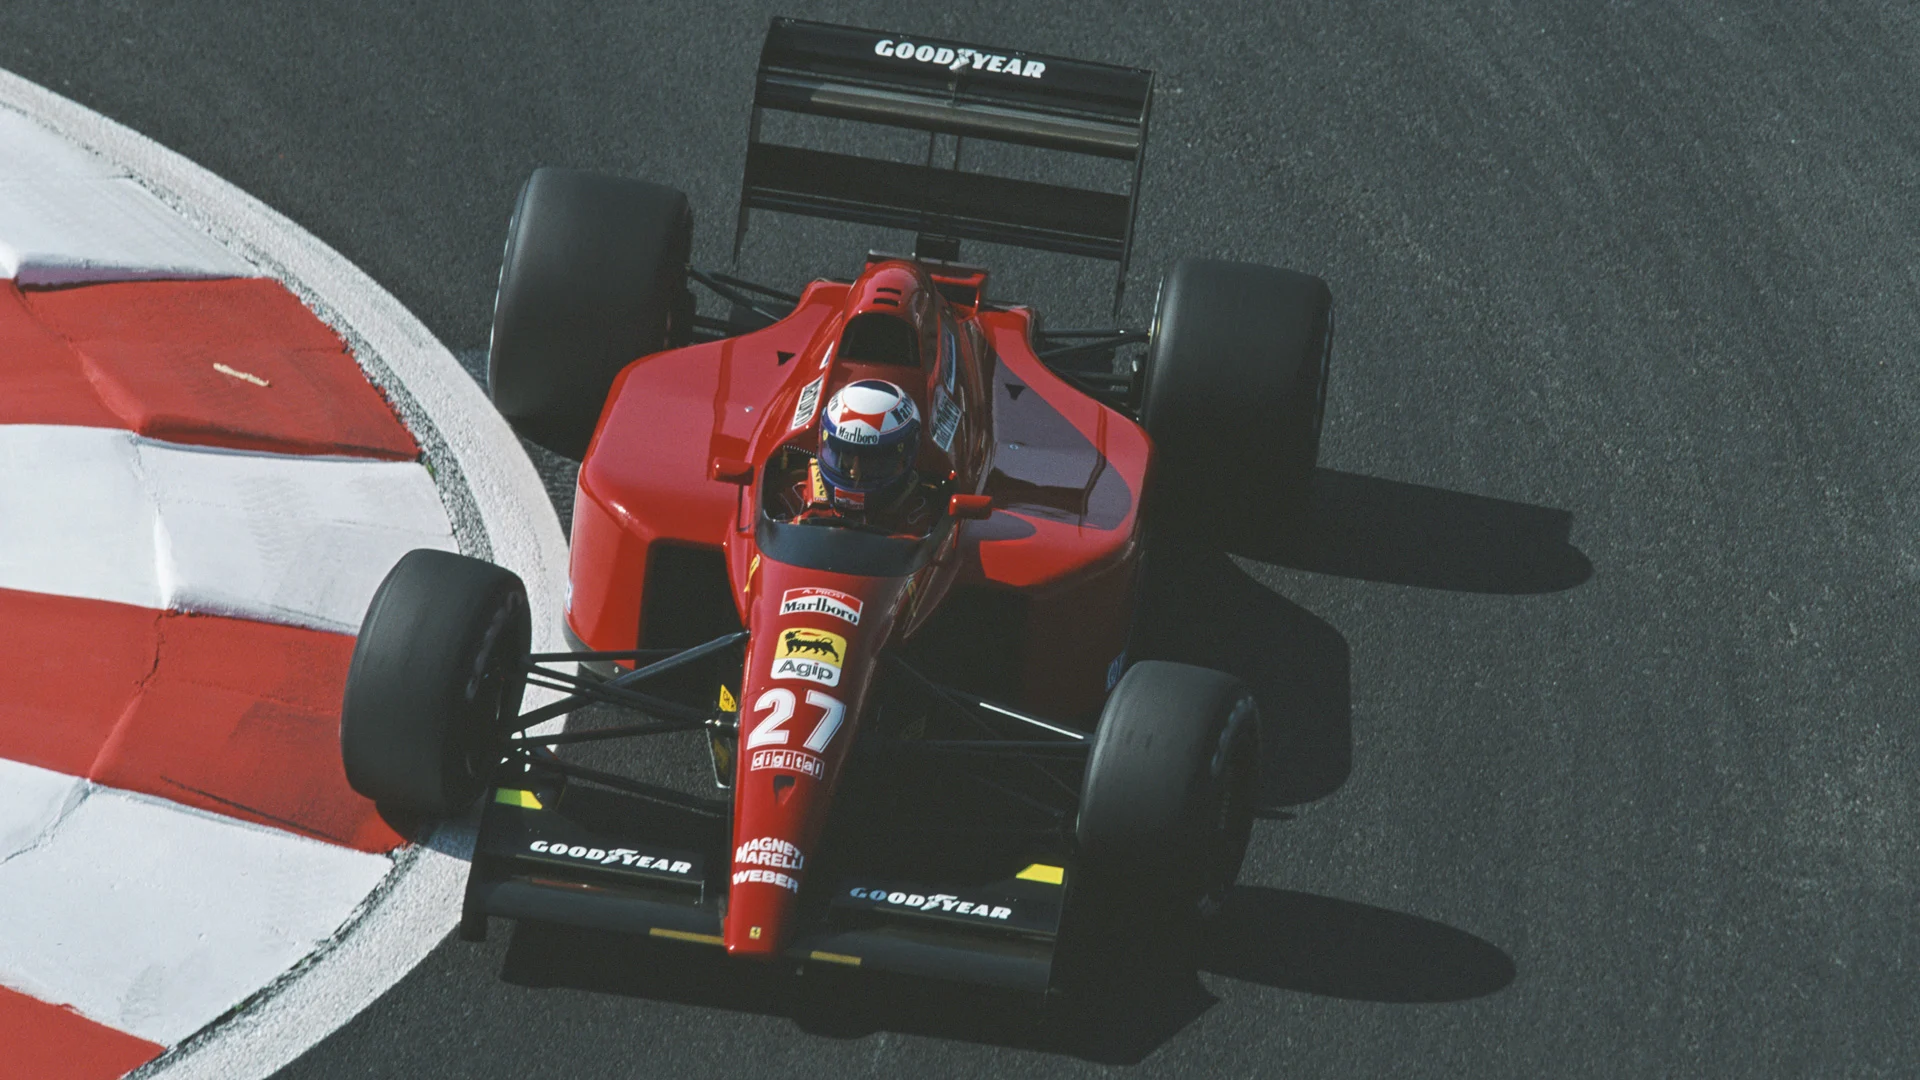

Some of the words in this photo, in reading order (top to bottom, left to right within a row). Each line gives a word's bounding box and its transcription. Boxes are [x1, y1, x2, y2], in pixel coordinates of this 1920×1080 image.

[874, 40, 1046, 78] GOODYEAR
[838, 426, 878, 444] Marlboro
[783, 598, 858, 623] Marlboro
[778, 660, 833, 680] Agip
[747, 688, 846, 753] 27
[752, 752, 822, 776] digital
[529, 840, 692, 874] GOODYEAR
[732, 870, 799, 894] WEBER
[850, 887, 1012, 920] GOODYEAR
